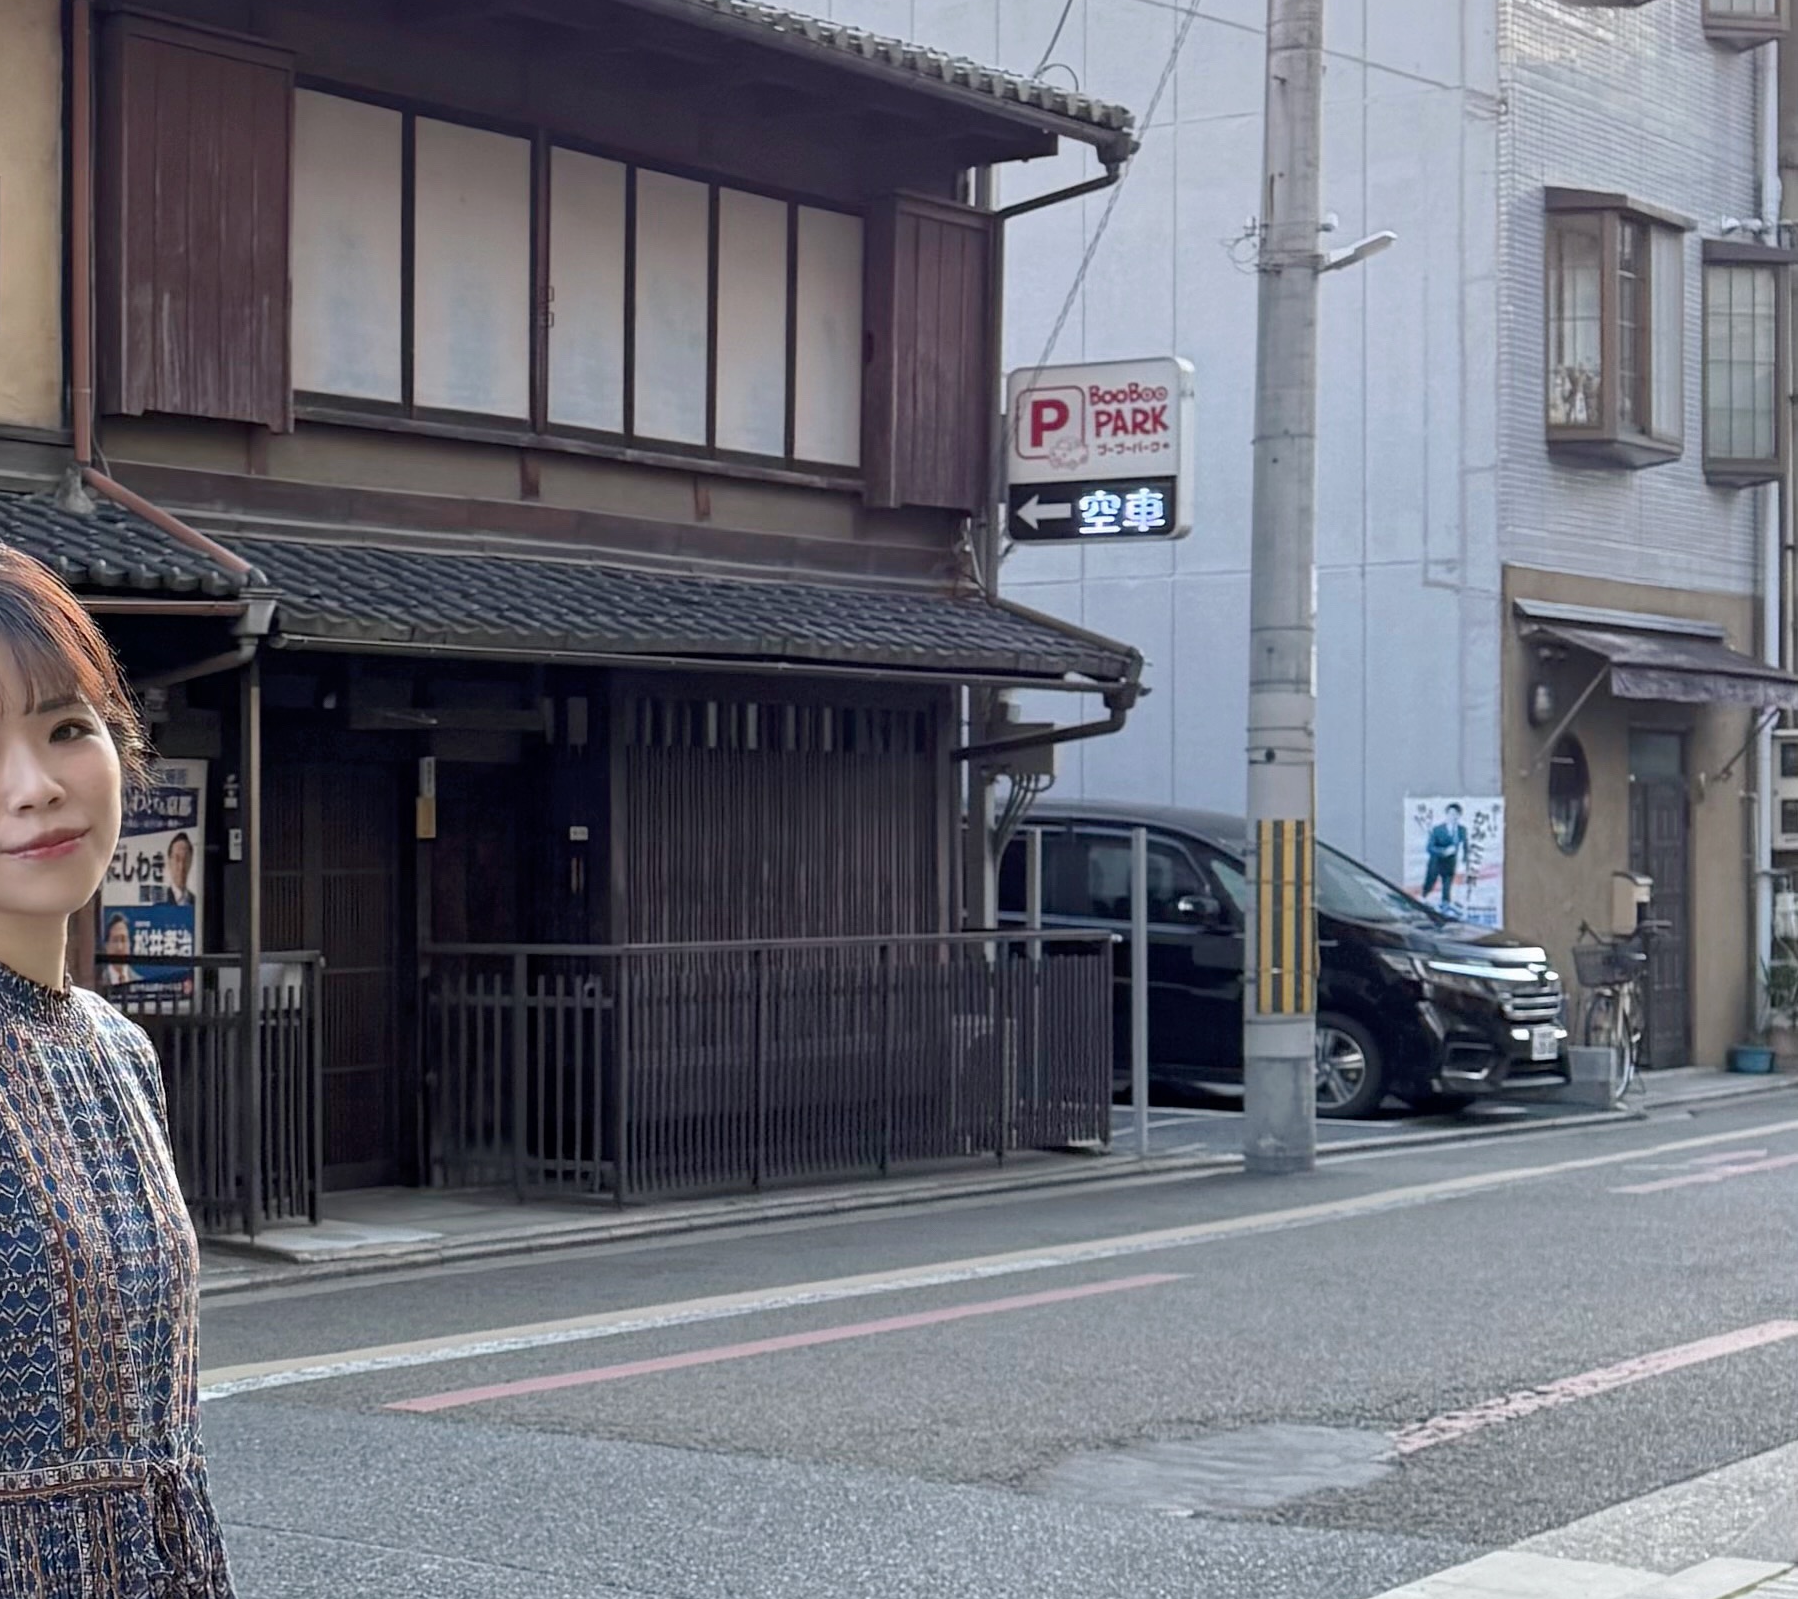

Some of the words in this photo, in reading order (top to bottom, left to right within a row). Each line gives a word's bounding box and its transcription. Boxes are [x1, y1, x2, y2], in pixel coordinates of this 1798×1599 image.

[1088, 382, 1168, 406] BooBoo
[1030, 398, 1070, 448] P
[1094, 403, 1170, 438] PARK
[1078, 487, 1166, 535] 空車
